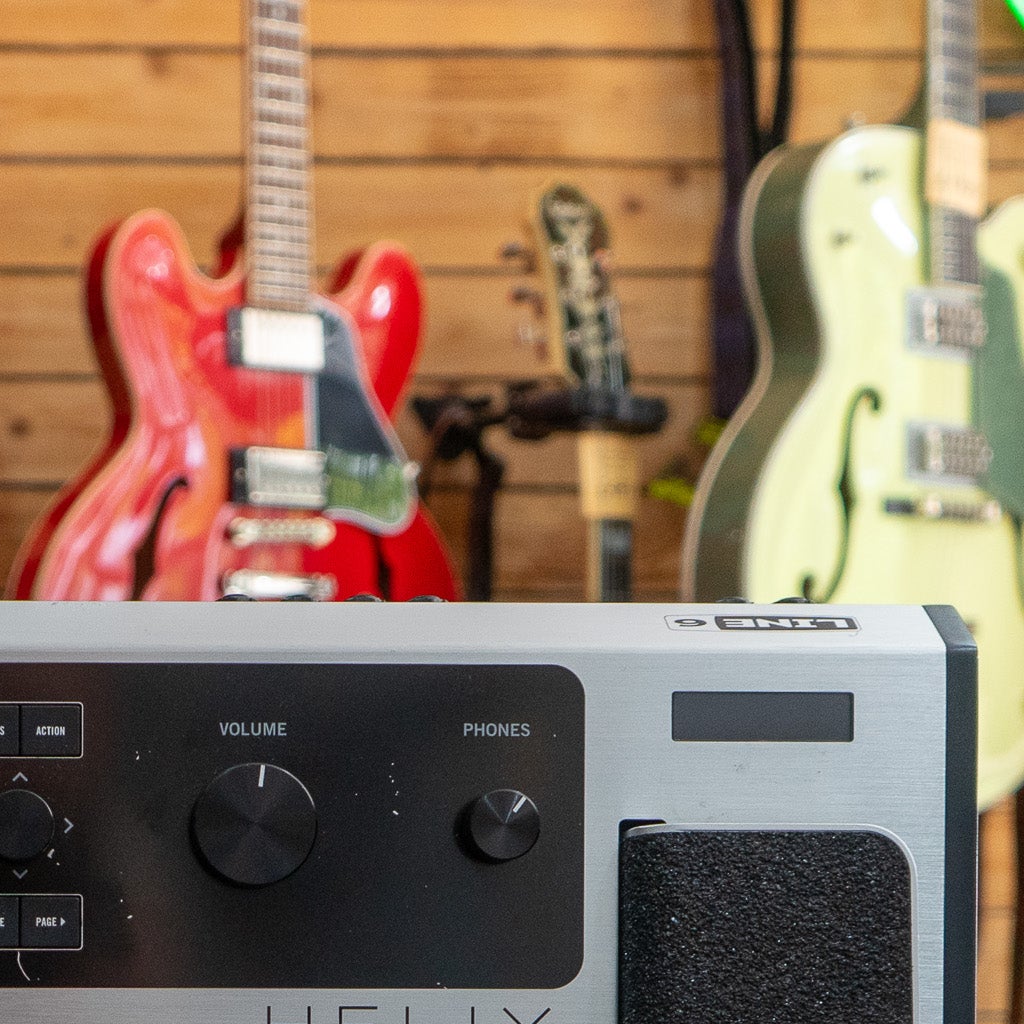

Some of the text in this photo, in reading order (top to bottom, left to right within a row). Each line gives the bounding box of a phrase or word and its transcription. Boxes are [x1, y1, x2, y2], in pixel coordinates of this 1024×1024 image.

[674, 617, 854, 629] LINE 6
[35, 726, 66, 737] ACTION
[219, 722, 287, 737] VOLUME
[463, 723, 531, 737] PHONES
[35, 917, 57, 928] PAGE
